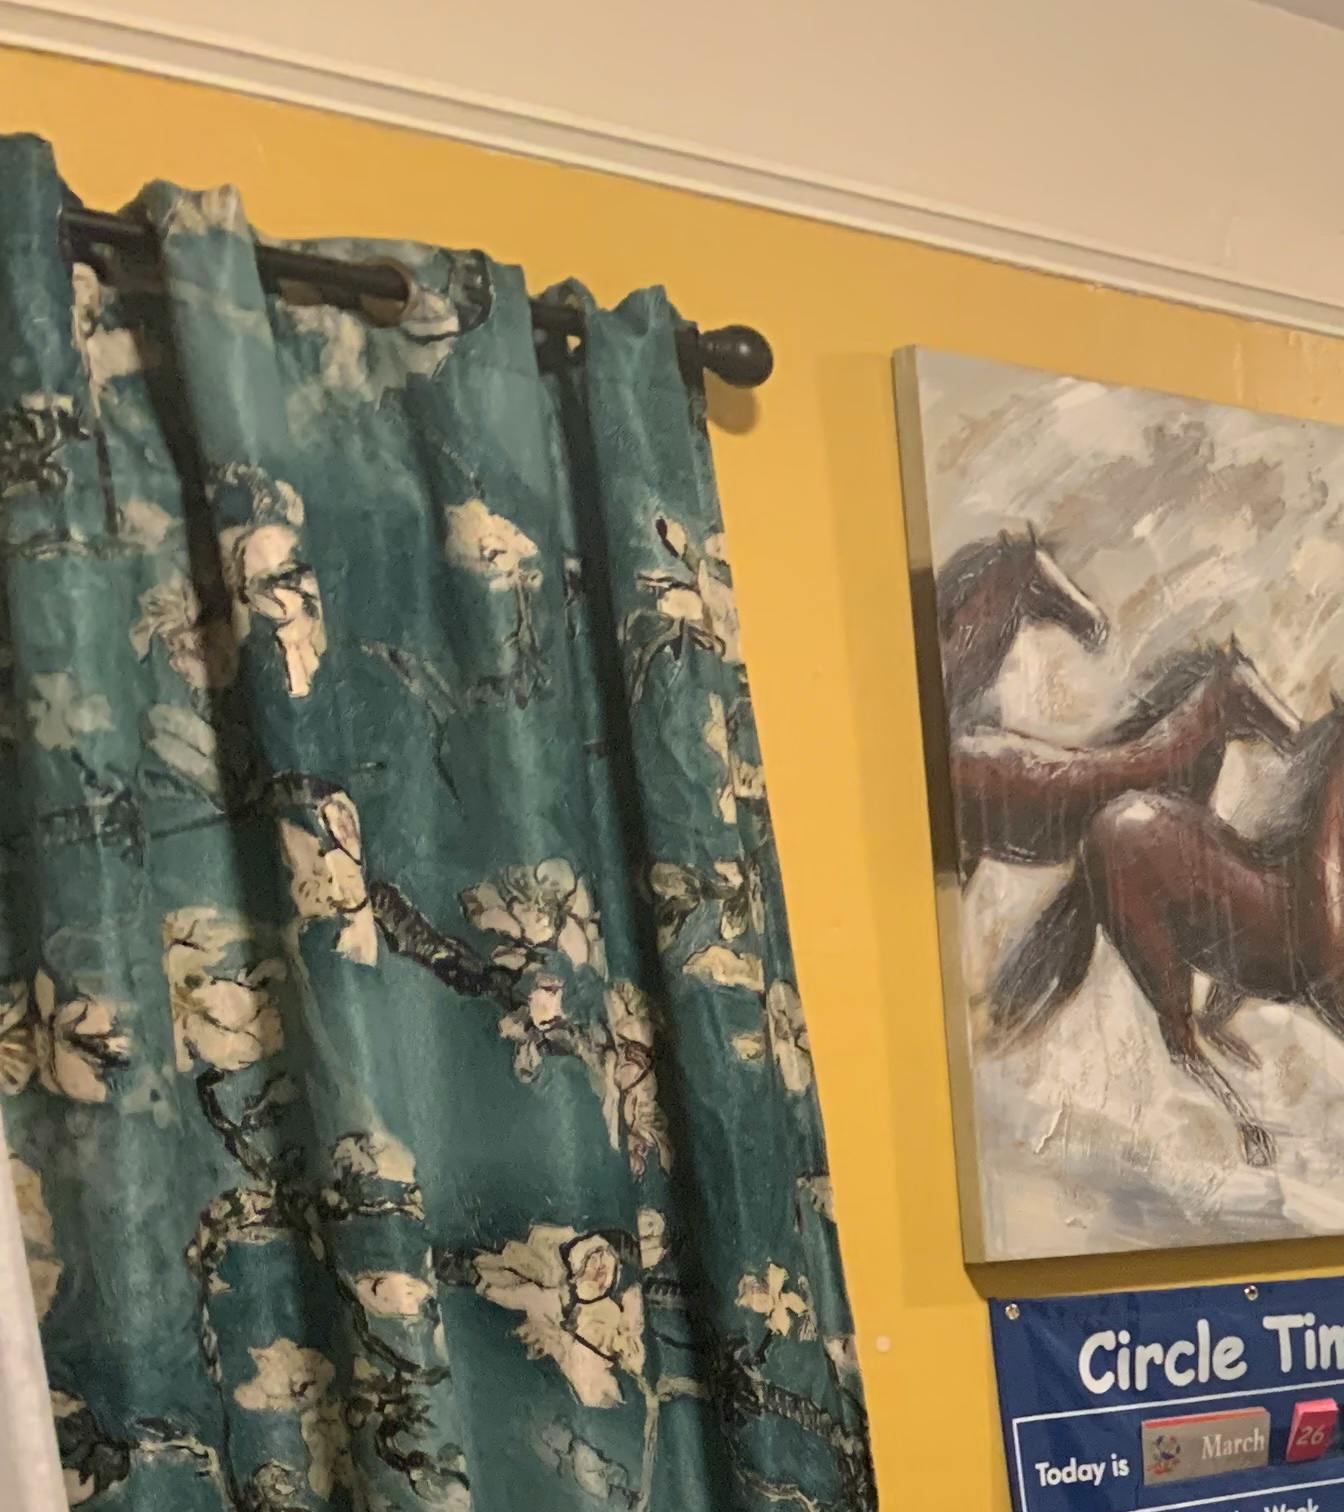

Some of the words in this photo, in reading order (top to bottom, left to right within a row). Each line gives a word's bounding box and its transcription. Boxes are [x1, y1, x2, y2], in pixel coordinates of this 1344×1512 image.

[1078, 1319, 1247, 1394] Circle
[1201, 1427, 1266, 1461] March
[1296, 1425, 1326, 1446] 26
[1035, 1459, 1106, 1487] Today
[1112, 1454, 1130, 1477] is
